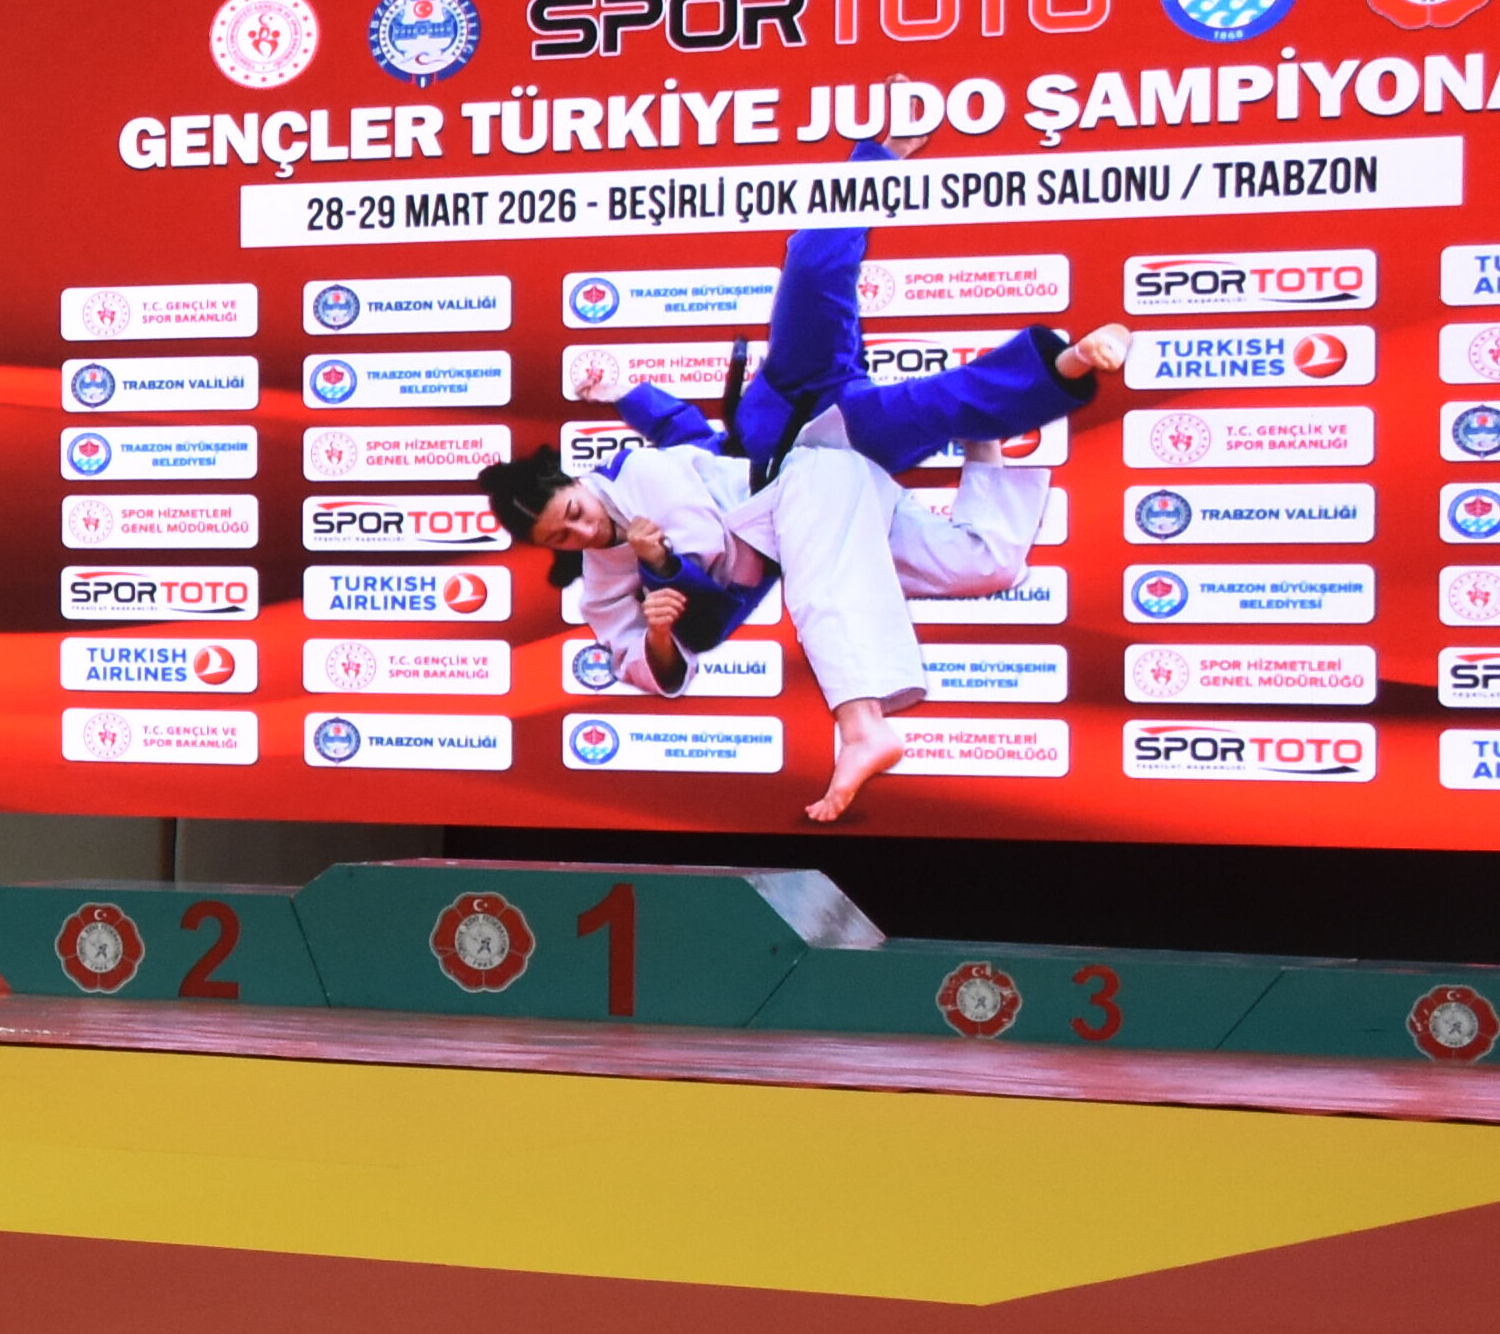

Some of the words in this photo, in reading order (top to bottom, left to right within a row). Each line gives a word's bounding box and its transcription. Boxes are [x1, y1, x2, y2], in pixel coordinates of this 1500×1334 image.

[117, 104, 444, 180] GENÇLER
[461, 77, 781, 155] TÜRKİYE
[796, 77, 1007, 143] JUDO
[1023, 46, 1500, 148] ŞAMPİYON
[306, 194, 395, 232] 28-29
[404, 191, 489, 228] MART
[497, 188, 577, 225] 2026
[607, 177, 725, 227] BEŞİRLİ
[735, 179, 798, 223] ÇOK
[807, 174, 930, 219] AMAÇLI
[941, 168, 1026, 209] SPOR
[1037, 164, 1171, 207] SALONU
[1181, 163, 1203, 200] /
[1212, 155, 1378, 200] TRABZON
[905, 274, 943, 284] SPOR
[904, 288, 954, 300] GENEL
[222, 300, 237, 309] VE
[367, 300, 432, 312] TRABZON
[142, 314, 171, 324] SPOR
[1155, 338, 1285, 358] TURKISH
[628, 359, 665, 368] SPOR
[1155, 359, 1285, 378] AIRLINES
[628, 373, 675, 384] GENEL
[122, 379, 184, 390] TRABZON
[1329, 424, 1348, 435] VE
[366, 441, 400, 451] SPOR
[1226, 440, 1263, 451] SPOR
[366, 455, 409, 466] GENEL
[121, 509, 154, 518] SPOR
[1200, 508, 1280, 521] TRABZON
[121, 523, 162, 533] GENEL
[330, 575, 436, 592] TURKISH
[329, 595, 437, 611] AIRLINES
[86, 647, 188, 664] TURKISH
[473, 656, 489, 666] VE
[703, 660, 767, 675] VALİLİĞİ
[1200, 660, 1241, 670] SPOR
[86, 666, 188, 682] AIRLINES
[388, 669, 420, 678] SPOR
[1200, 675, 1253, 687] GENEL
[223, 727, 237, 736] VE
[368, 736, 433, 747] TRABZON
[905, 732, 944, 743] SPOR
[143, 739, 172, 748] SPOR
[904, 748, 953, 759] GENEL
[179, 899, 241, 1000] 2
[578, 883, 636, 1017] 1
[1071, 964, 1123, 1042] 3
